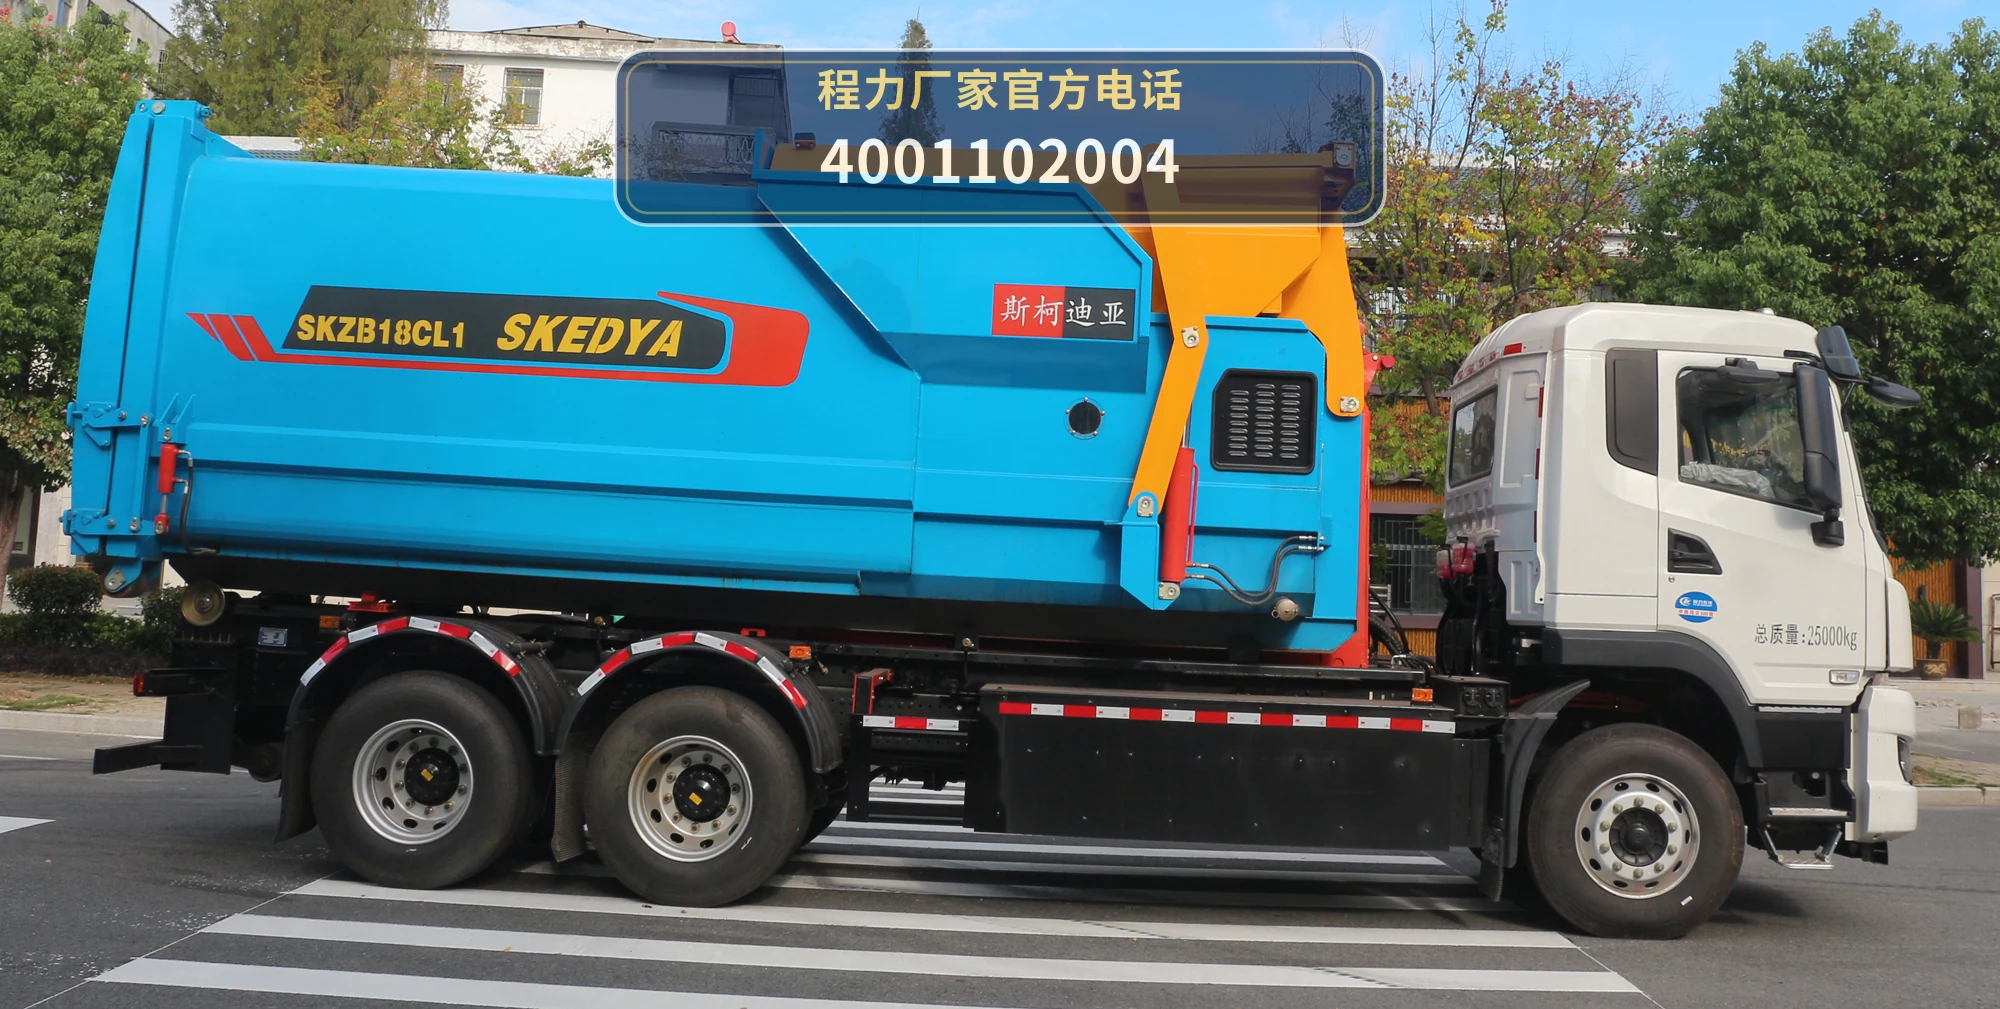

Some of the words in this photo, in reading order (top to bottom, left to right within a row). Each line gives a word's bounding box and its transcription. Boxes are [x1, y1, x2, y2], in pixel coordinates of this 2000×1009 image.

[1000, 294, 1127, 327] 斯柯迪亚
[296, 314, 465, 348] SKZB18CL1
[496, 313, 683, 357] SKEDYA
